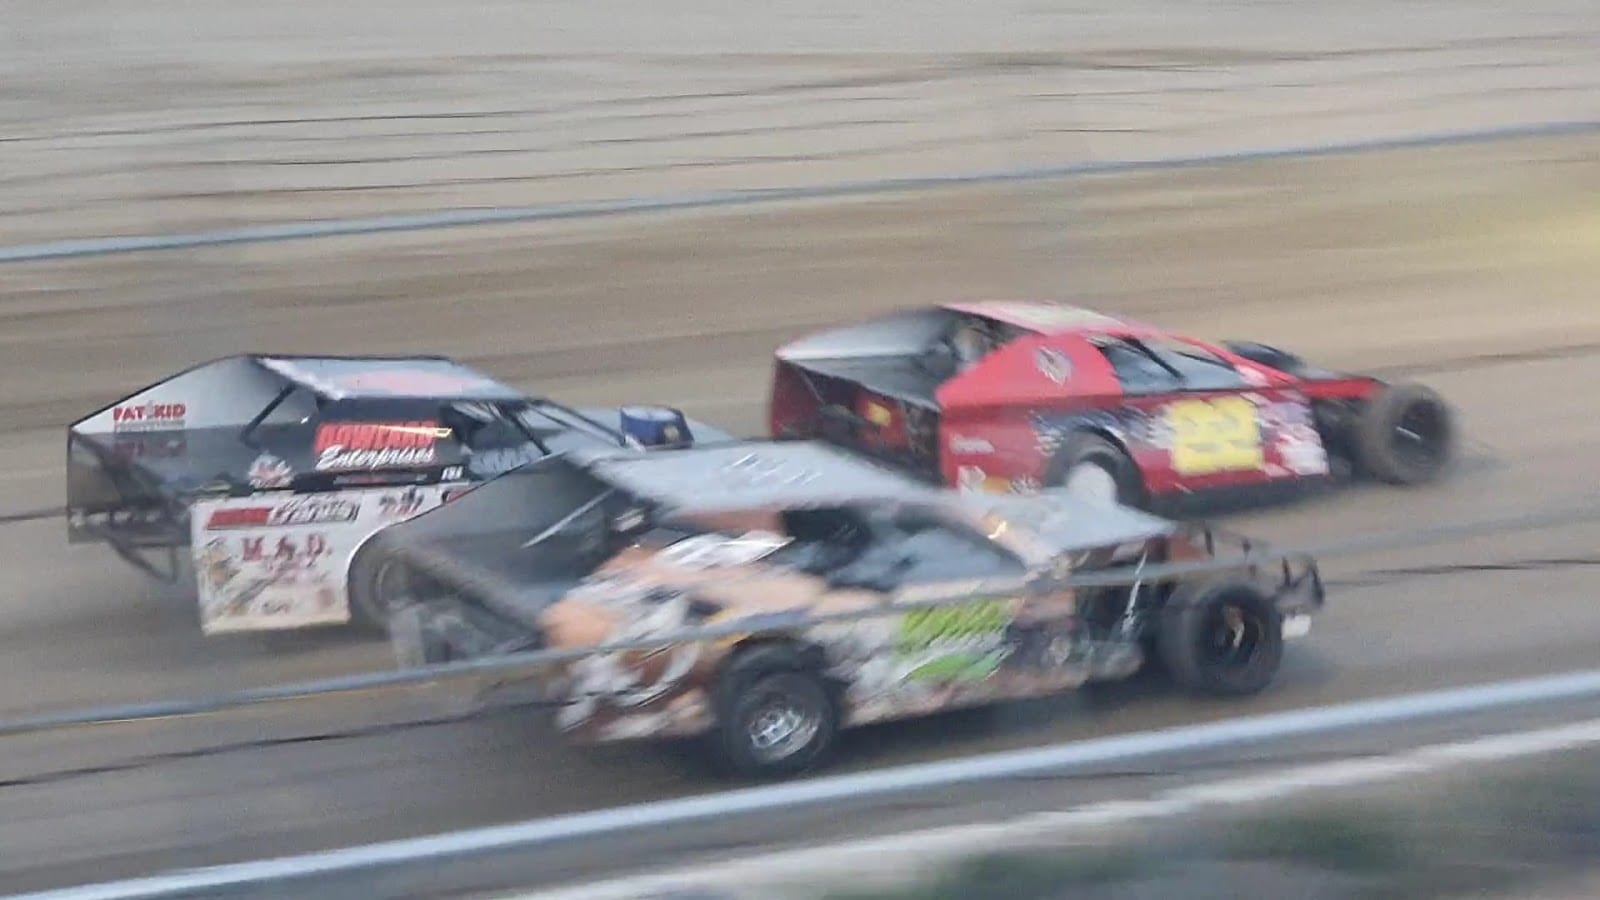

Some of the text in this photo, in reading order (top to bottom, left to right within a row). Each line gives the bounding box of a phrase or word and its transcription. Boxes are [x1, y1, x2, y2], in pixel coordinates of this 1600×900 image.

[113, 403, 186, 421] FAT KID
[315, 444, 434, 470] Enterprises
